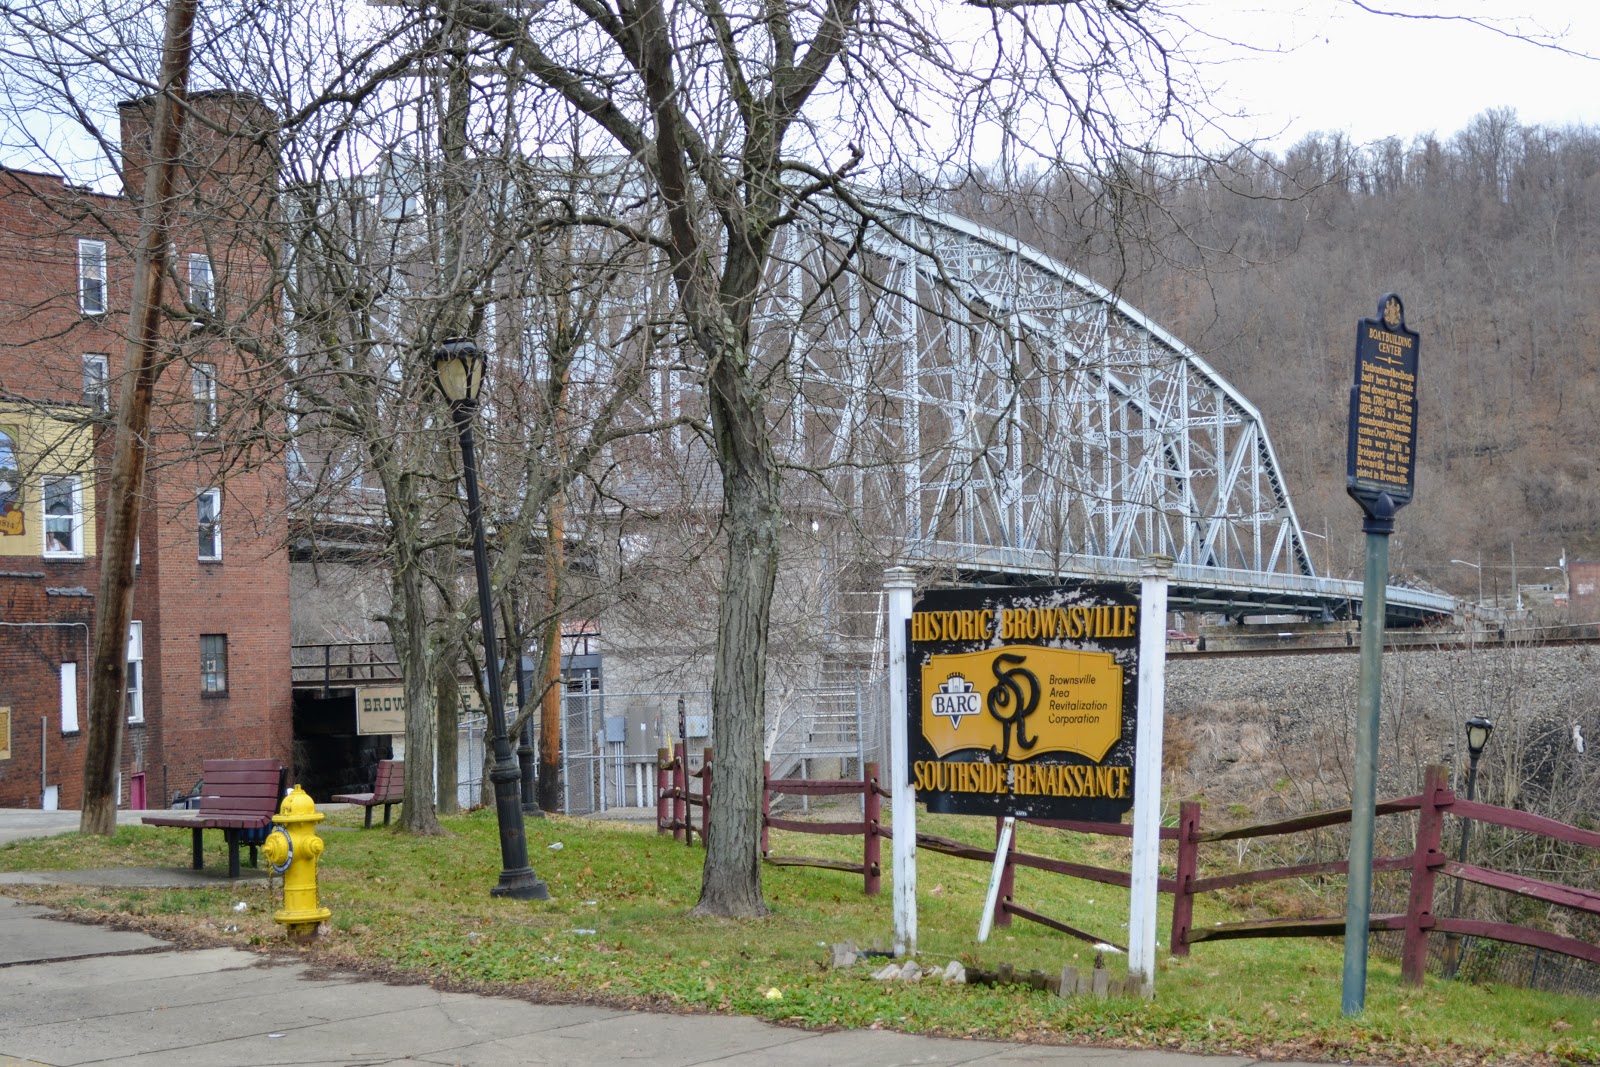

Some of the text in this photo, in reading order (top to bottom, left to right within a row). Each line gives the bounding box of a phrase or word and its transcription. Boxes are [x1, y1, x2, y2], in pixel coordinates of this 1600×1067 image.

[1369, 328, 1411, 348] BOATBUILDING
[1379, 342, 1402, 357] CENTER
[1362, 371, 1413, 392] built here for trade
[1361, 383, 1370, 393] and
[1371, 385, 1396, 399] downriver
[1400, 401, 1412, 413] From
[1359, 415, 1411, 433] steamboat construction
[1394, 410, 1412, 425] leading
[1375, 427, 1386, 438] Over
[1358, 434, 1410, 454] boats were built in
[1358, 445, 1410, 464] Bridgeport and West
[1357, 455, 1385, 470] Brownsville
[1386, 462, 1396, 472] and
[1357, 467, 1373, 479] pleted
[911, 605, 1137, 641] HISTORIC BROWNSVILLE
[1050, 674, 1096, 685] Brownsville
[1050, 688, 1070, 698] Area
[935, 695, 977, 713] BARC
[1049, 700, 1108, 711] Revitalization
[1049, 713, 1100, 726] Corporation
[913, 760, 1131, 798] SOUTHSIDE RENAISSANCE
